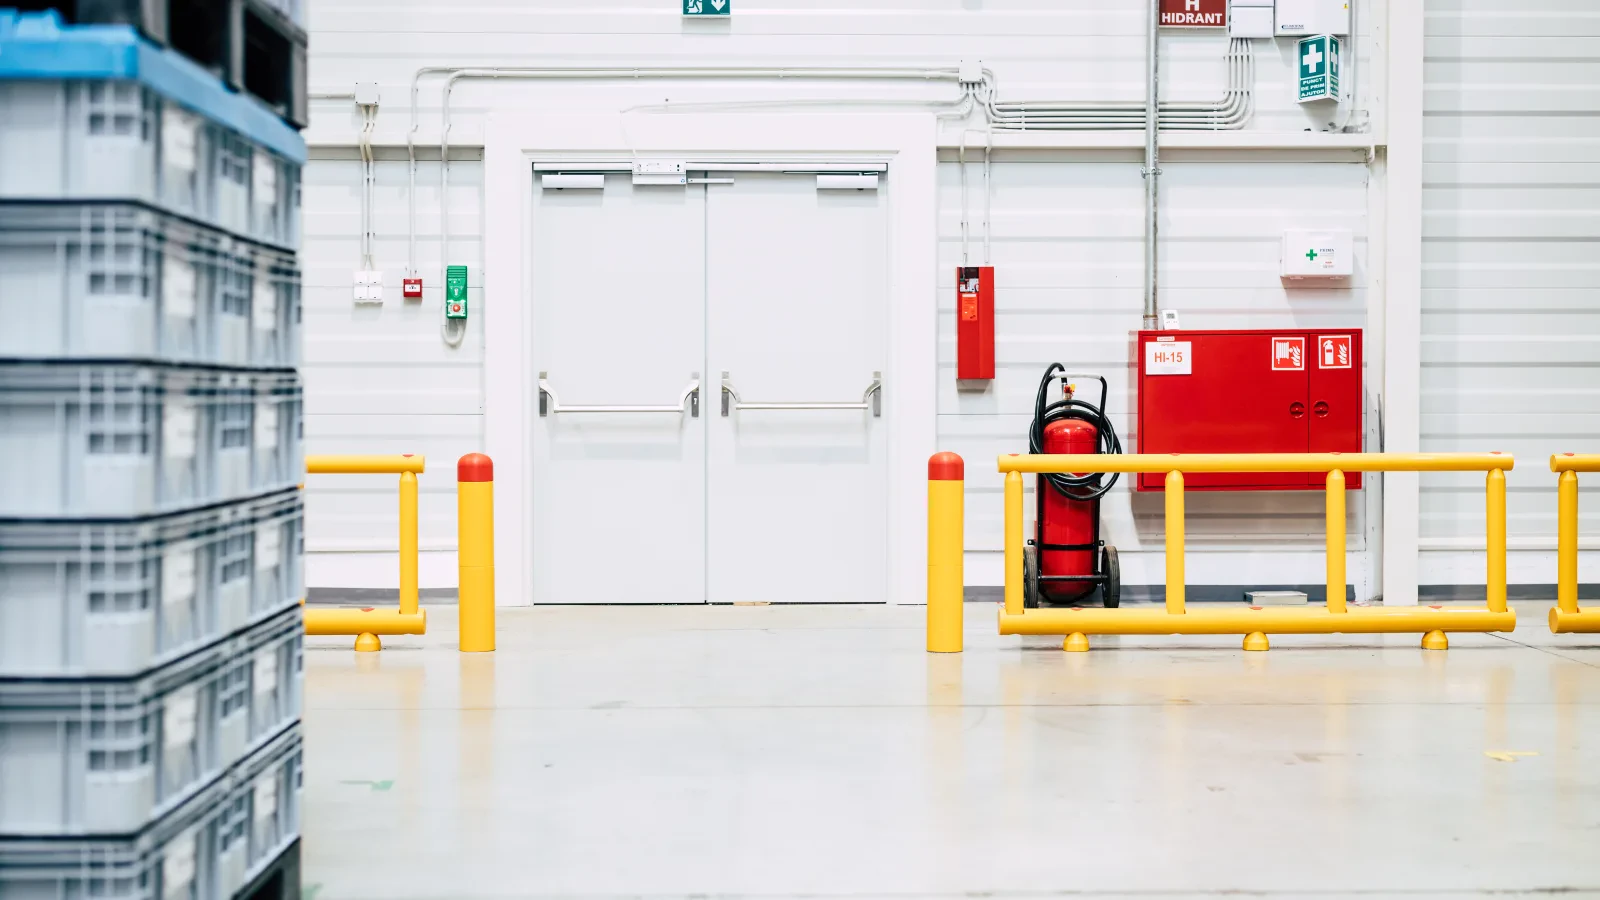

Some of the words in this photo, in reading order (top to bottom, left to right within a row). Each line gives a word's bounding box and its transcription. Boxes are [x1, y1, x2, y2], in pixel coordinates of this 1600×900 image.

[1185, 0, 1199, 11] H
[1161, 12, 1223, 24] HIDRANT
[1302, 77, 1323, 85] PUNCT
[1301, 89, 1325, 97] AJUTOR
[1154, 351, 1183, 363] HI-15
